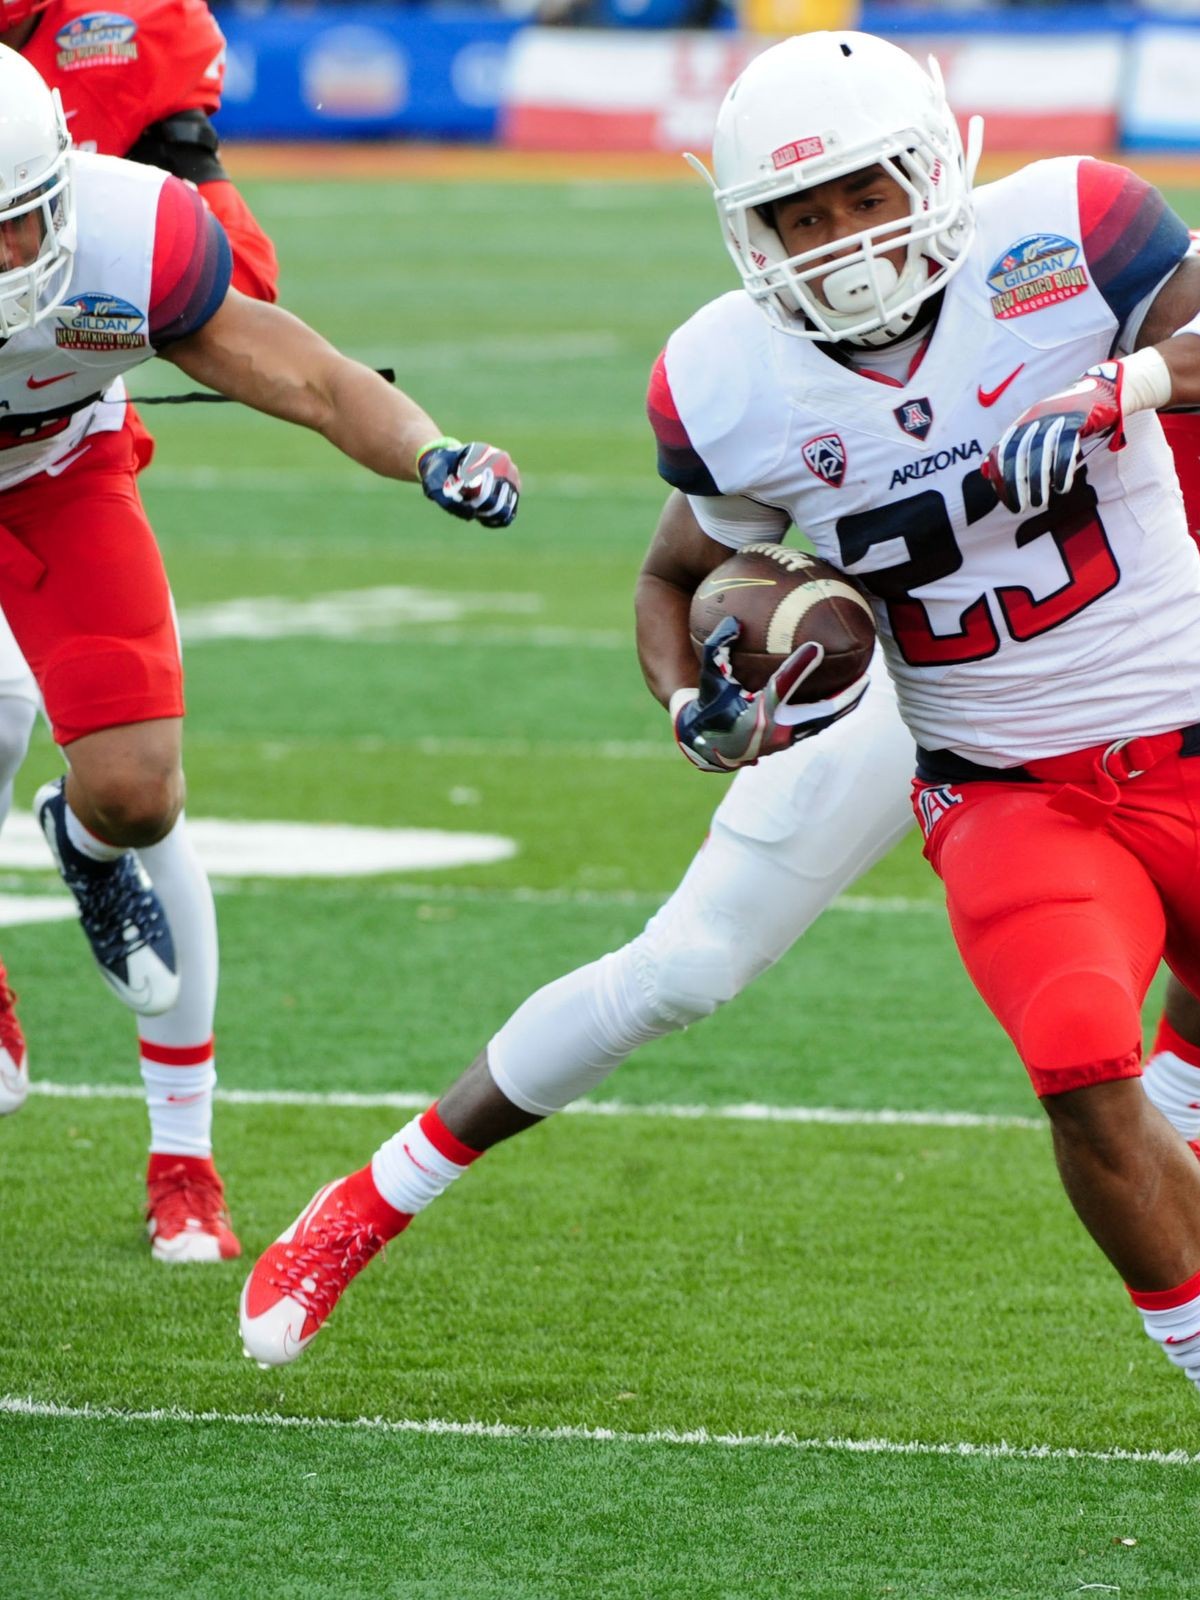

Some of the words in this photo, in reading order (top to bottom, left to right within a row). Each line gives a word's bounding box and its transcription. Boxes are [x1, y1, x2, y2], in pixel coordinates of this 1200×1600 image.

[992, 289, 1015, 315] NEW
[1014, 275, 1053, 303] MEXICO
[1052, 266, 1088, 289] BOWL
[1002, 254, 1065, 288] GILDAN
[56, 330, 77, 343] NEW
[80, 332, 114, 344] MEXICO
[71, 316, 129, 331] GILDAN
[888, 439, 983, 490] ARIZONA
[835, 462, 1120, 667] 23
